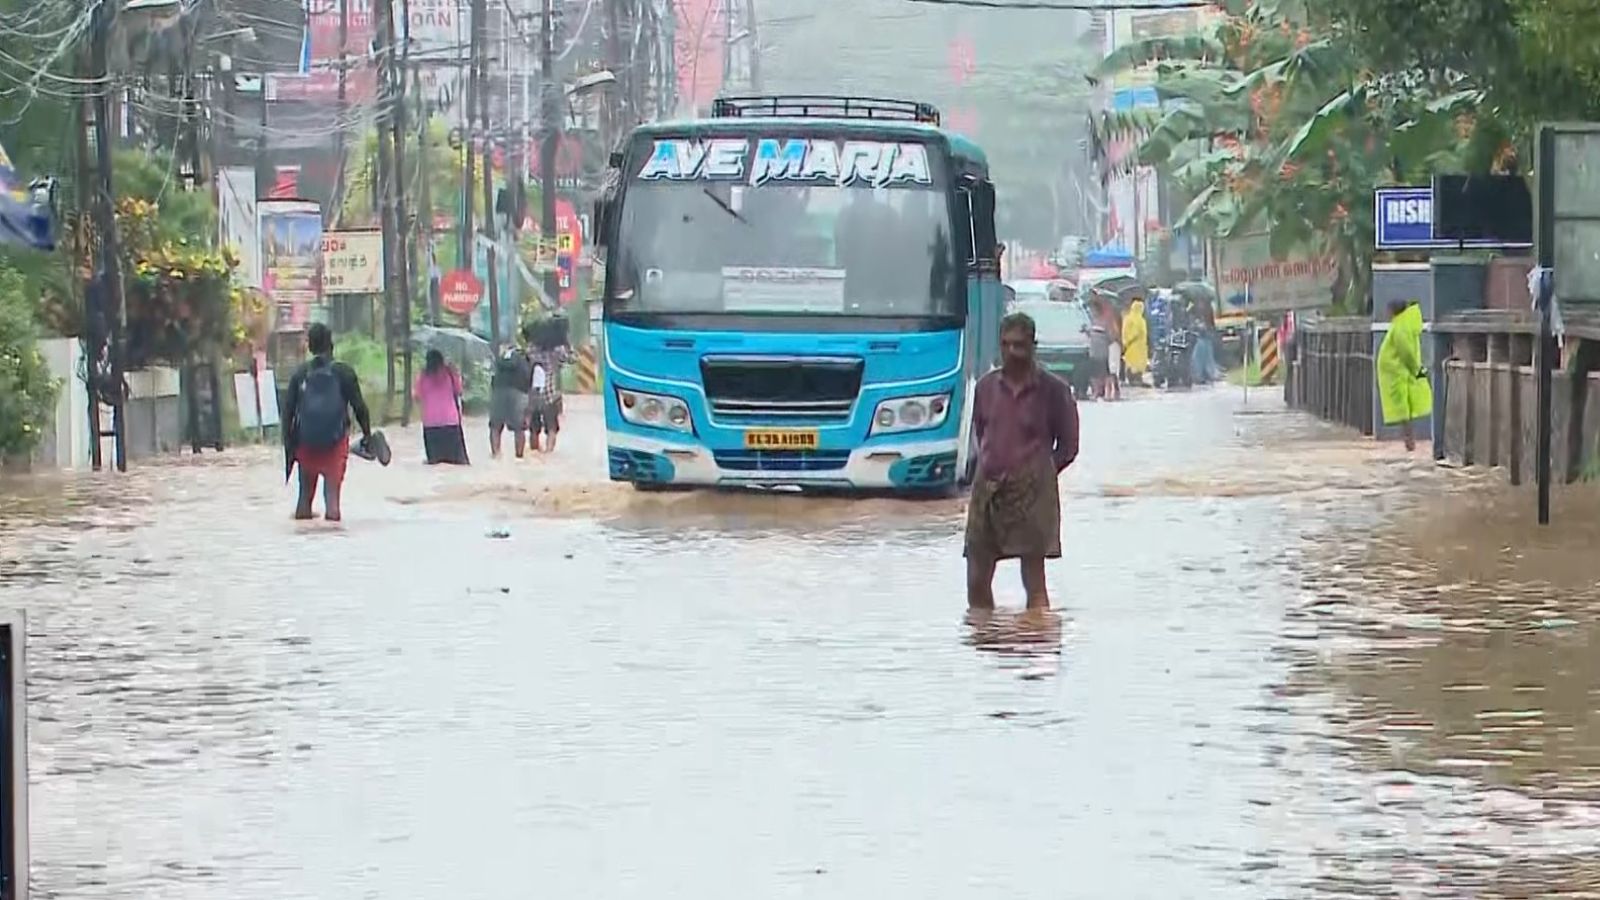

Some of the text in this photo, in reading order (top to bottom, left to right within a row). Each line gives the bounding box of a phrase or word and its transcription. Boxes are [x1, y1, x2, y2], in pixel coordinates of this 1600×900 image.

[637, 138, 932, 188] AVE MARIA
[1387, 199, 1431, 224] RISH
[455, 281, 468, 291] NO
